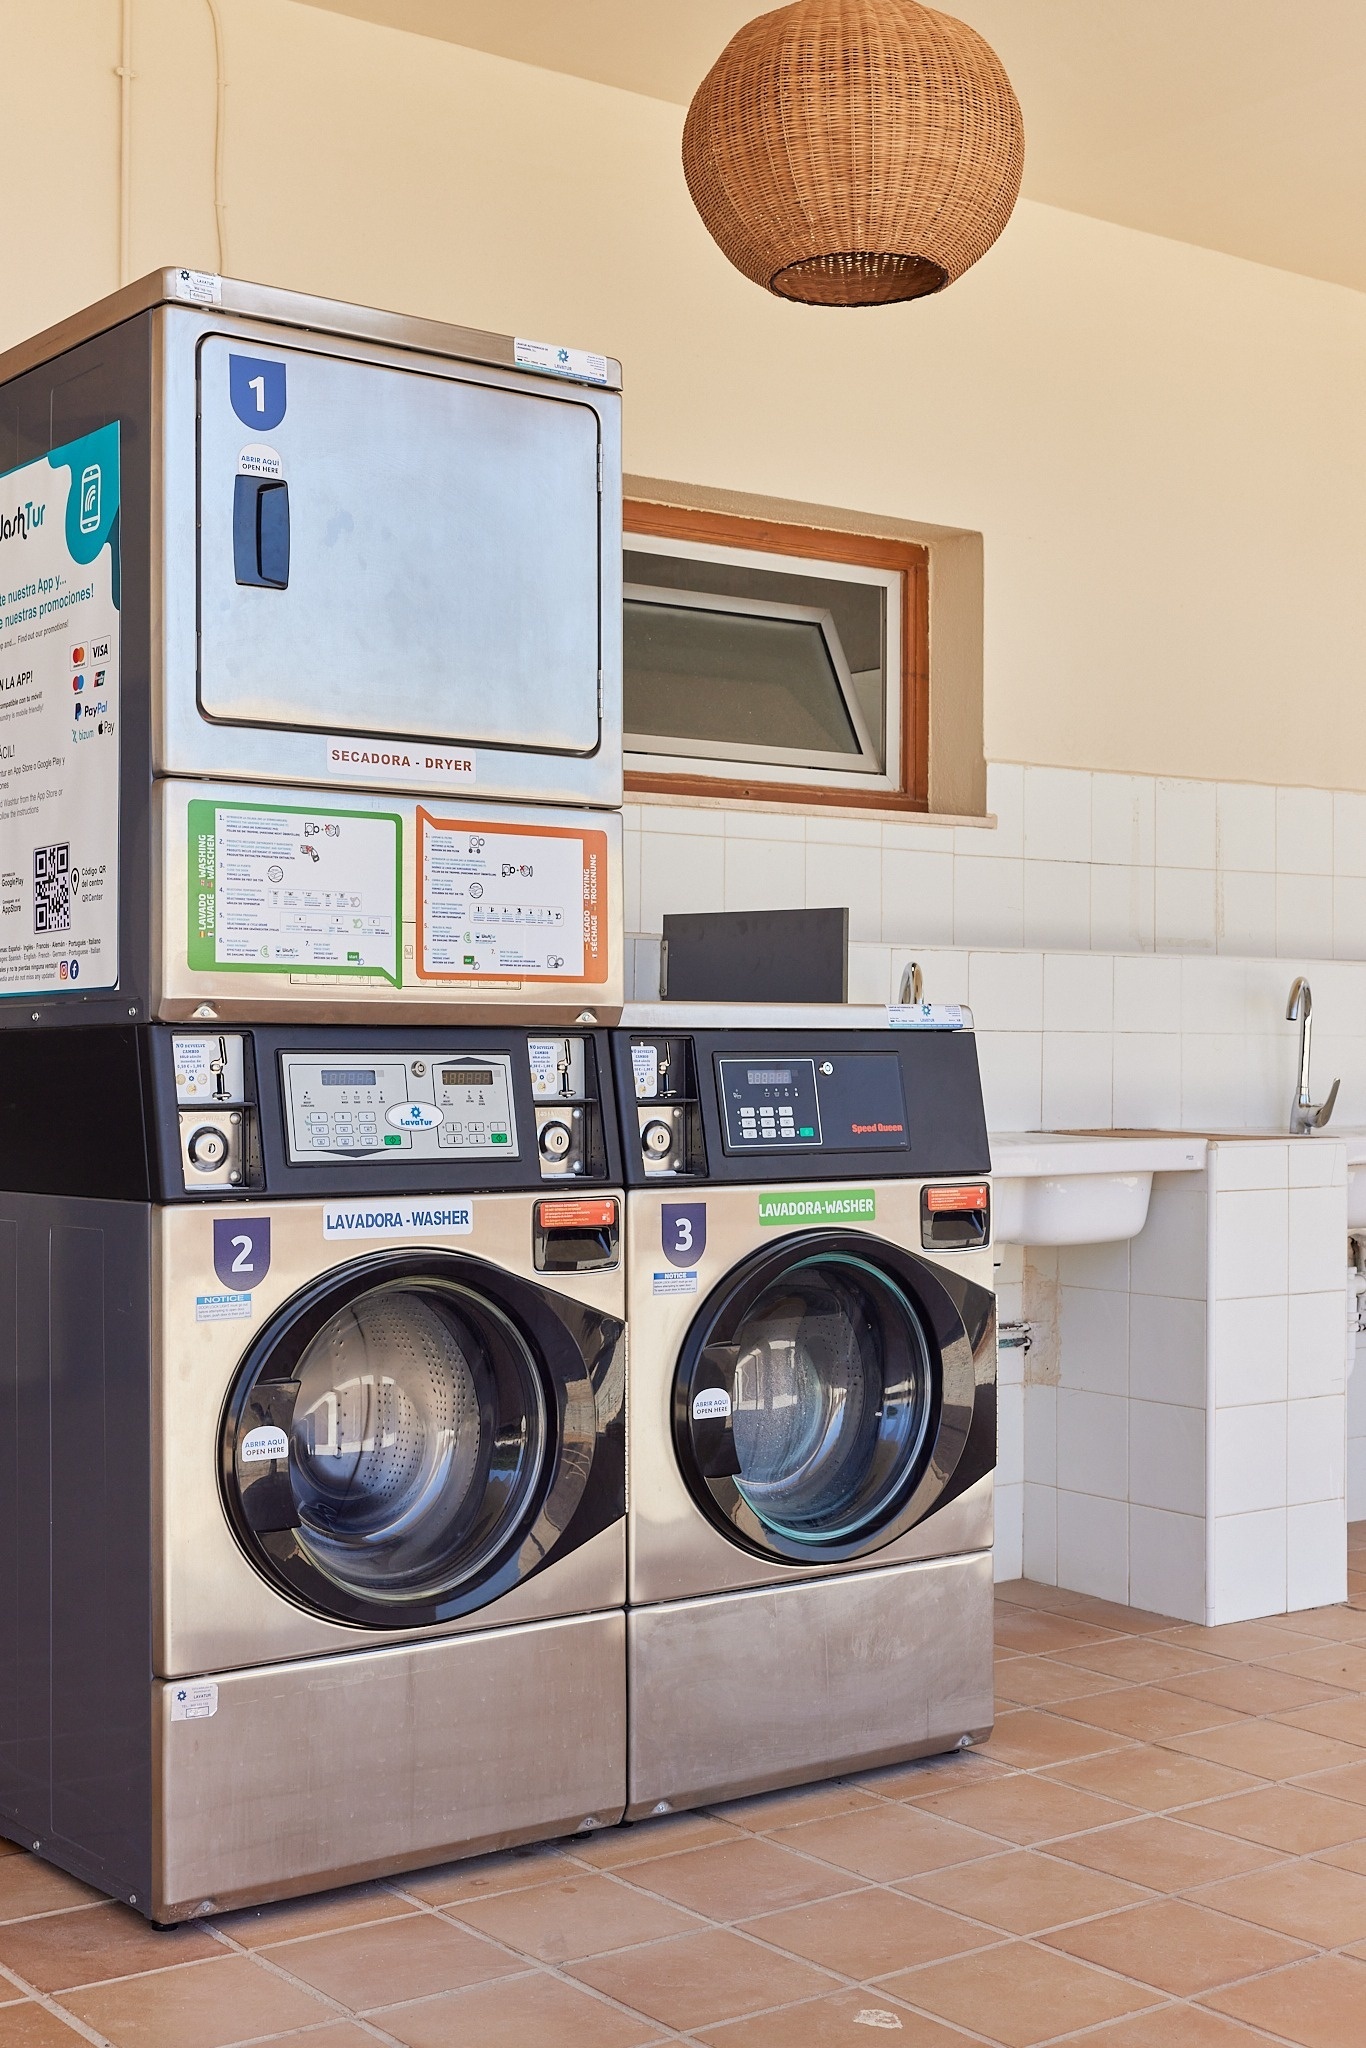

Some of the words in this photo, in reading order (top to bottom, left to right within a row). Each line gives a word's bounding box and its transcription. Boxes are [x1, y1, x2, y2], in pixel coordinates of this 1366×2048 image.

[248, 376, 264, 412] 1
[241, 455, 260, 463] ABRIR
[262, 465, 278, 474] HERE
[8, 584, 36, 604] nuestra
[38, 578, 53, 594] App
[5, 606, 37, 628] nuestras
[40, 583, 94, 619] promociones!
[92, 644, 108, 658] VISA
[5, 676, 15, 690] LA
[16, 670, 33, 687] APP!
[84, 701, 108, 718] PayPal
[78, 729, 94, 741] bizum
[104, 720, 115, 736] Pay
[332, 749, 411, 767] SECADORA
[425, 757, 472, 772] DRYER
[82, 868, 97, 876] Código
[99, 865, 106, 874] QR
[852, 1123, 877, 1134] Speed
[878, 1123, 902, 1131] Queen
[759, 1199, 873, 1217] LAVADORA-WASHER
[326, 1212, 403, 1230] LAVADORA
[675, 1218, 693, 1251] 3
[231, 1235, 253, 1272] 2
[204, 1295, 244, 1304] NOTICE
